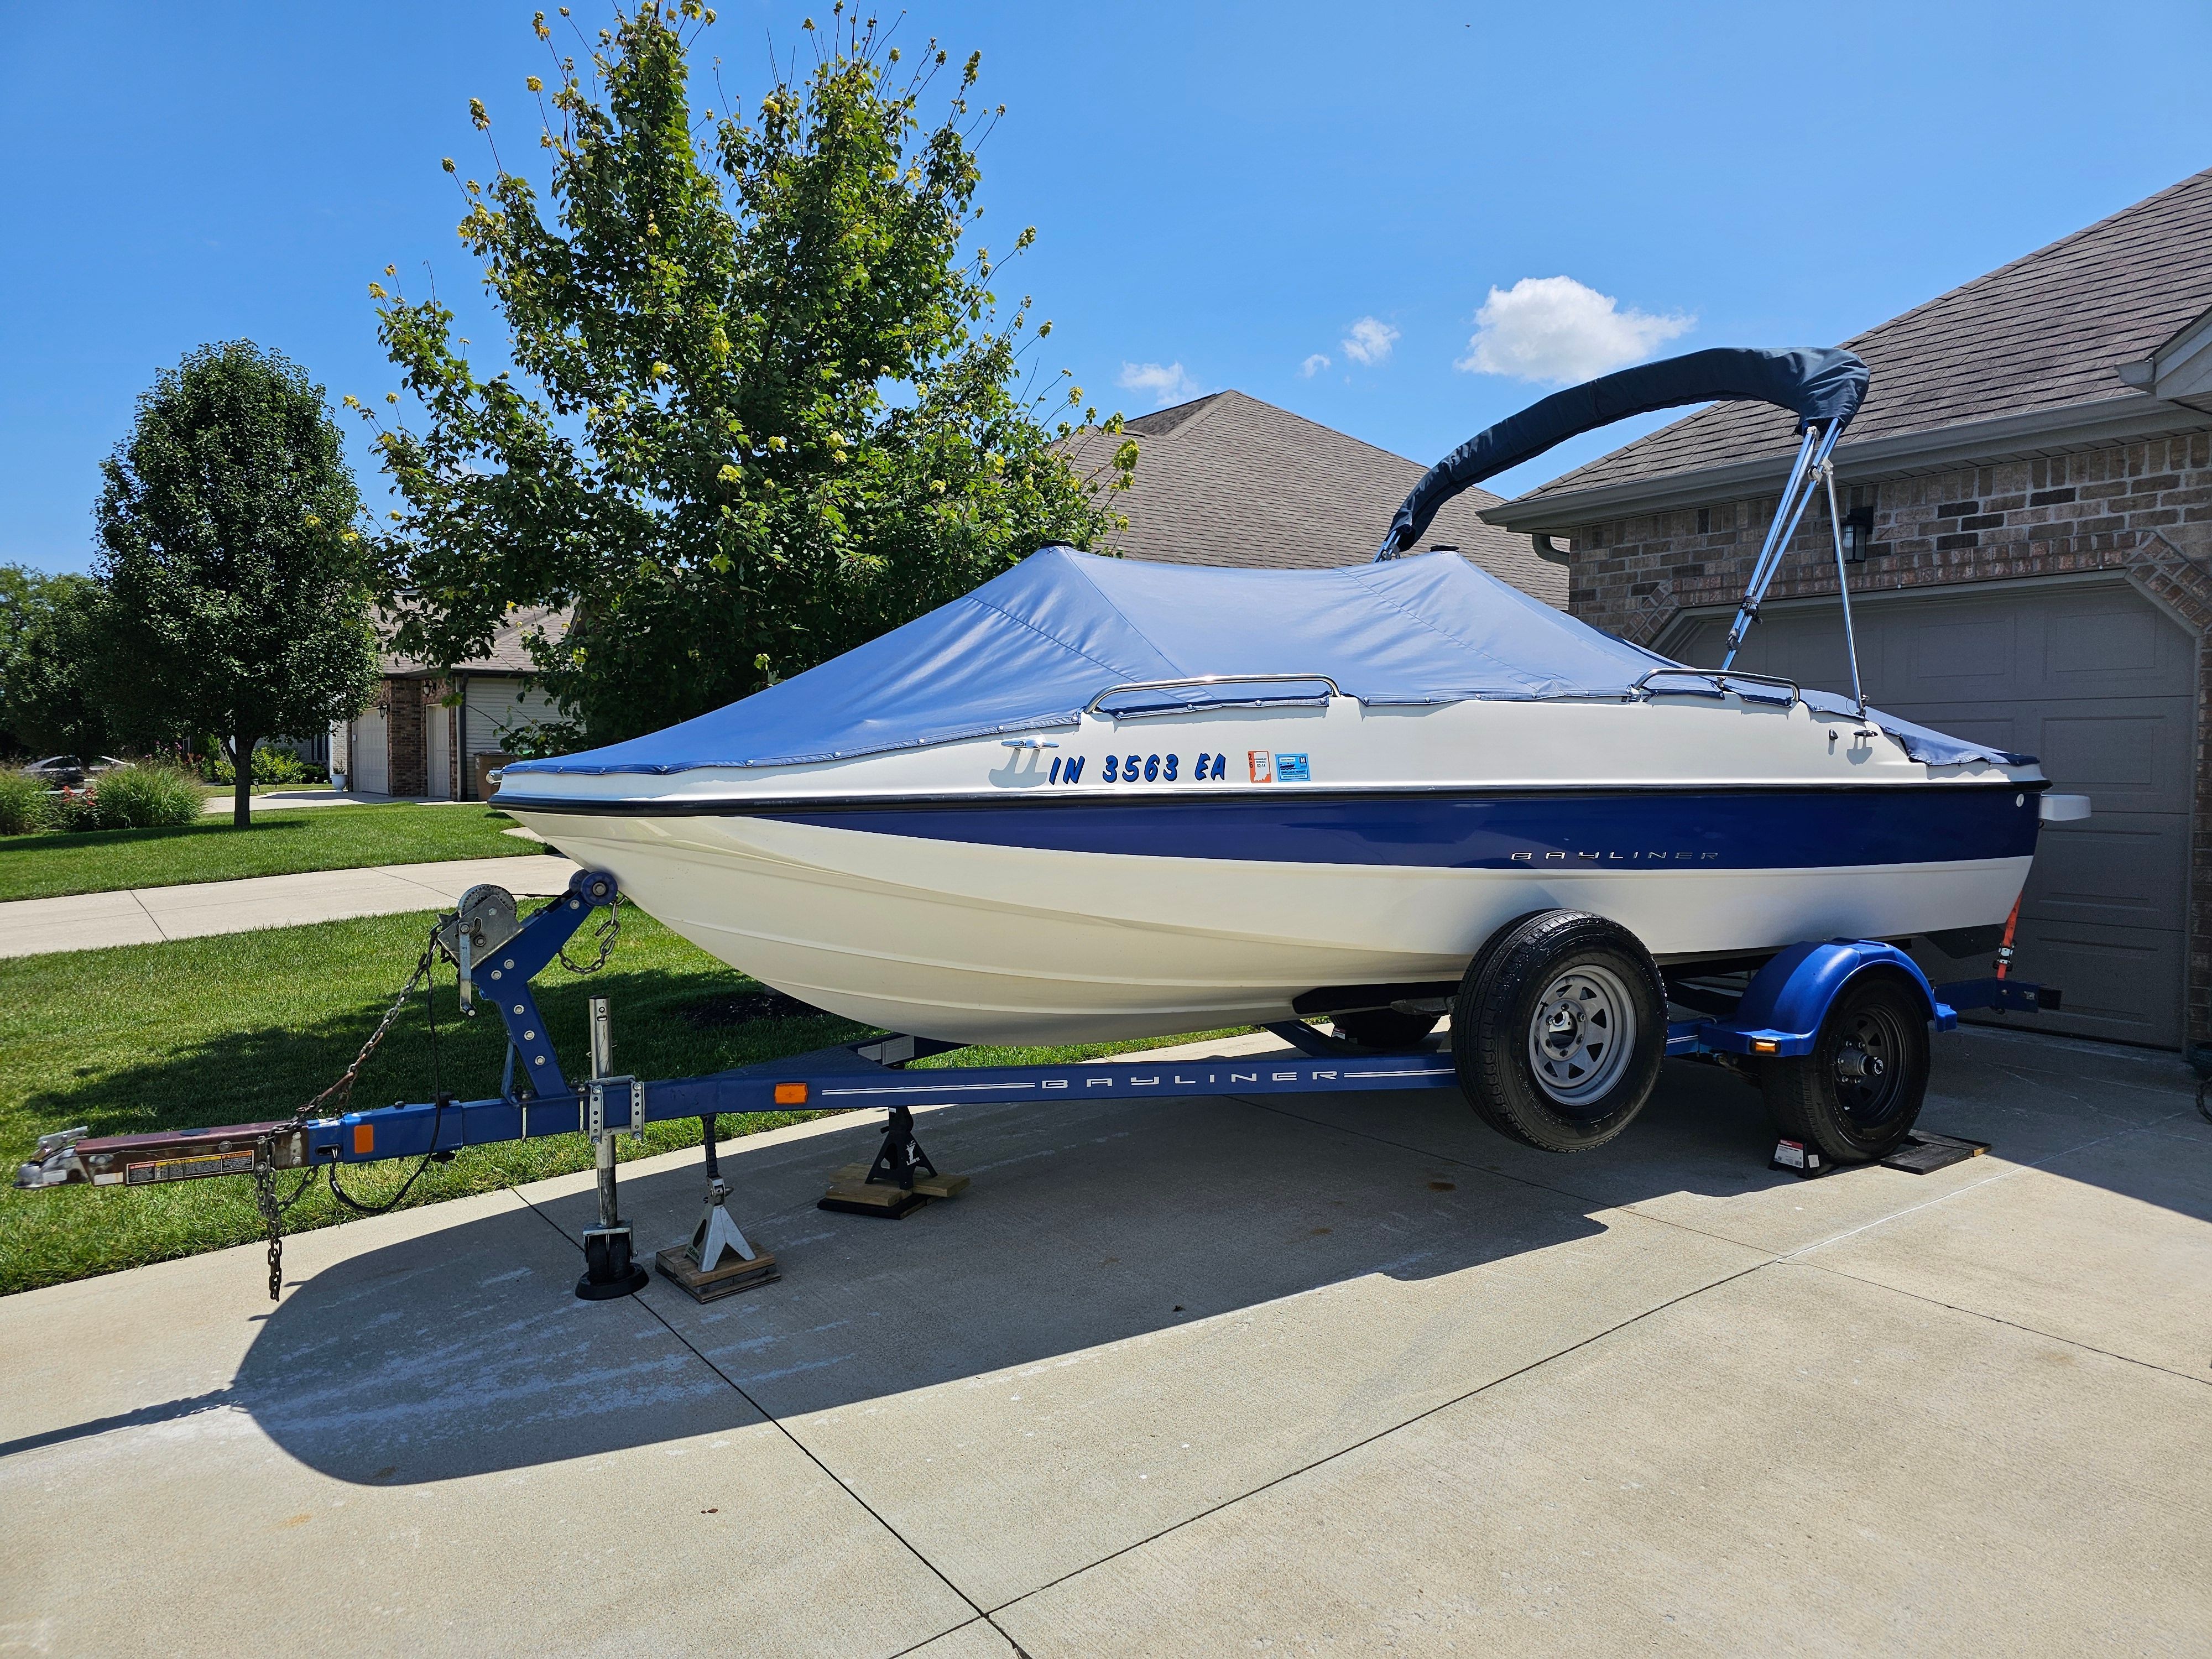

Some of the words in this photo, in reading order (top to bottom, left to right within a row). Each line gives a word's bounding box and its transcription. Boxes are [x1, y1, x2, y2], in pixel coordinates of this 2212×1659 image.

[1049, 756, 1085, 785] IN
[1102, 754, 1179, 783] 3563
[1194, 753, 1226, 780] EA
[1042, 1071, 1337, 1089] BAYLINER
